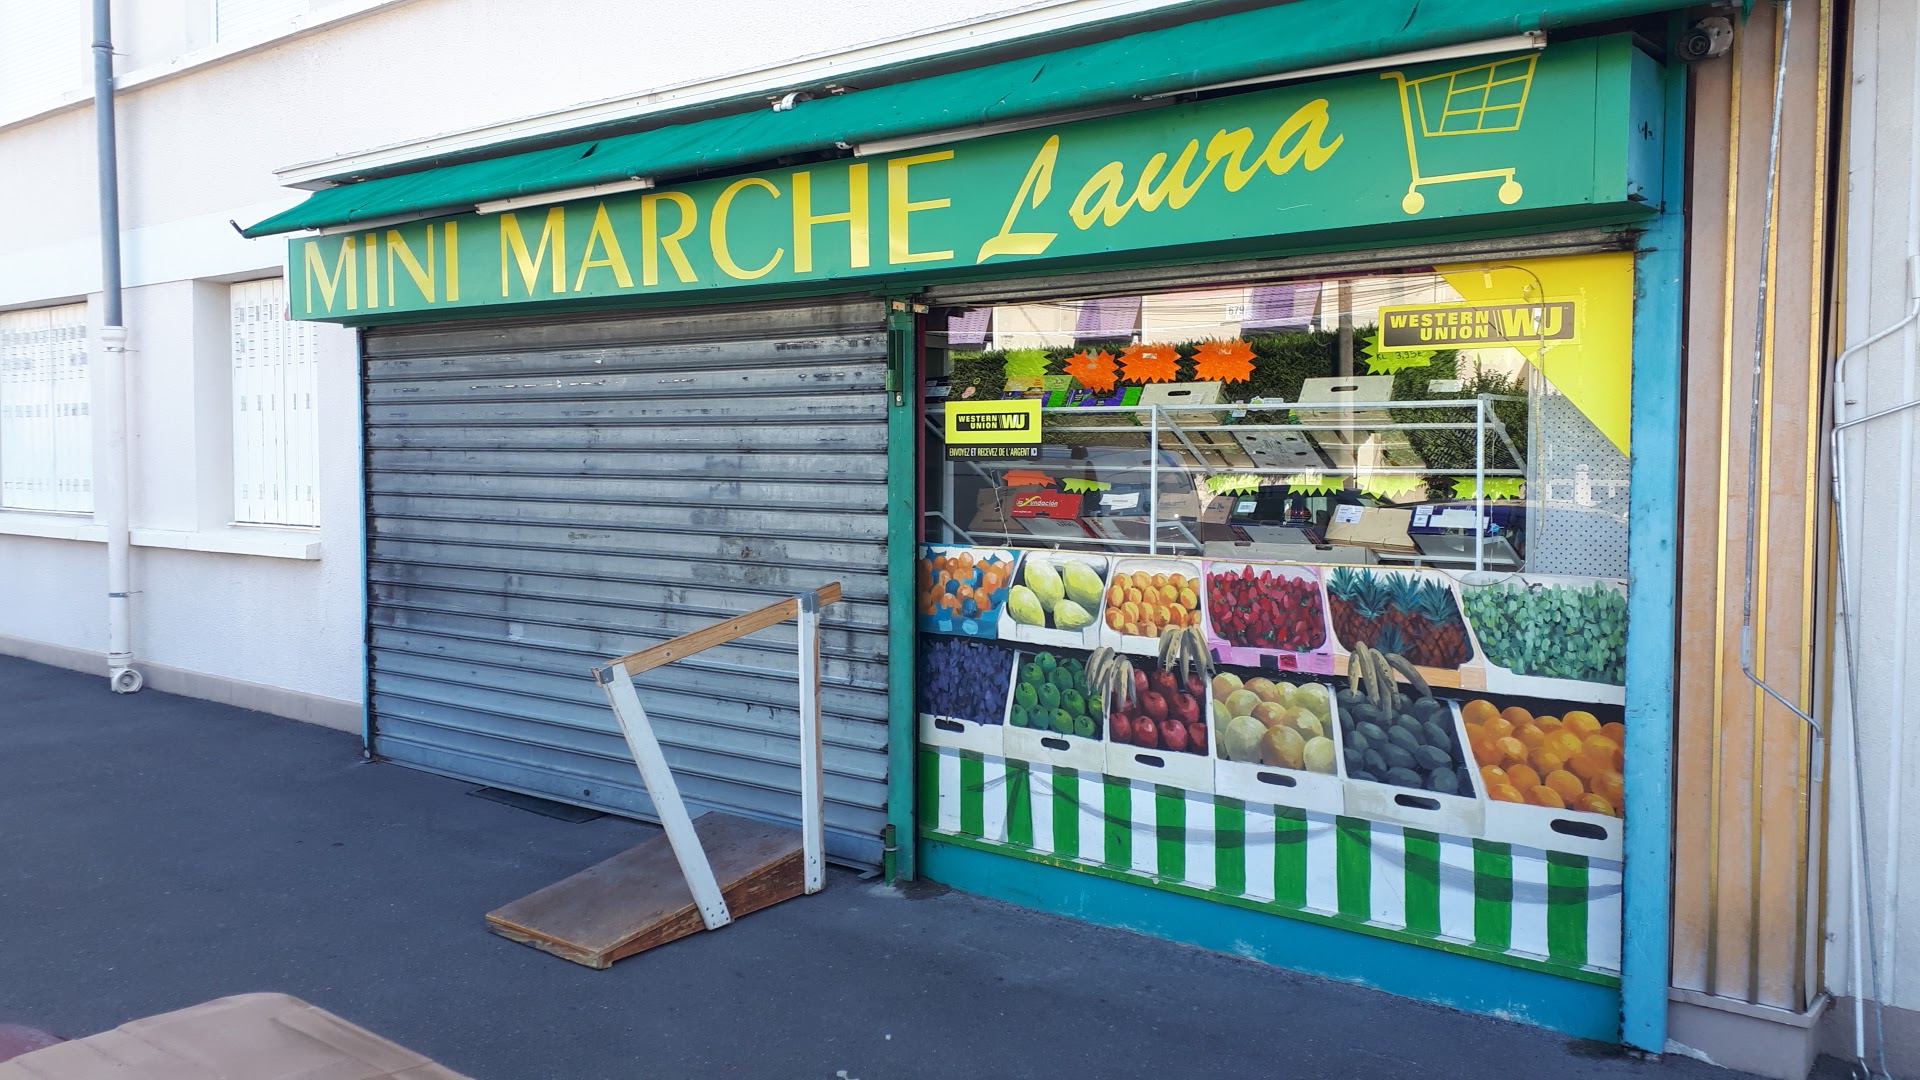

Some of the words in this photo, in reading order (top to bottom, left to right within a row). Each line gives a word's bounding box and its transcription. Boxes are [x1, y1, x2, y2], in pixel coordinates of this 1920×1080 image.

[304, 220, 460, 314] MINI
[501, 149, 955, 298] MARCHE
[976, 98, 1344, 264] Laura
[1389, 310, 1489, 329] WESTERN
[1501, 306, 1563, 337] WU
[1420, 325, 1489, 341] UNION
[1001, 414, 1025, 429] WU
[949, 447, 970, 456] ENVOYEZ
[971, 447, 976, 456] ET
[977, 447, 997, 456] RECEVEZ
[998, 447, 1005, 456] DE
[1006, 447, 1030, 456] L'ARGENT
